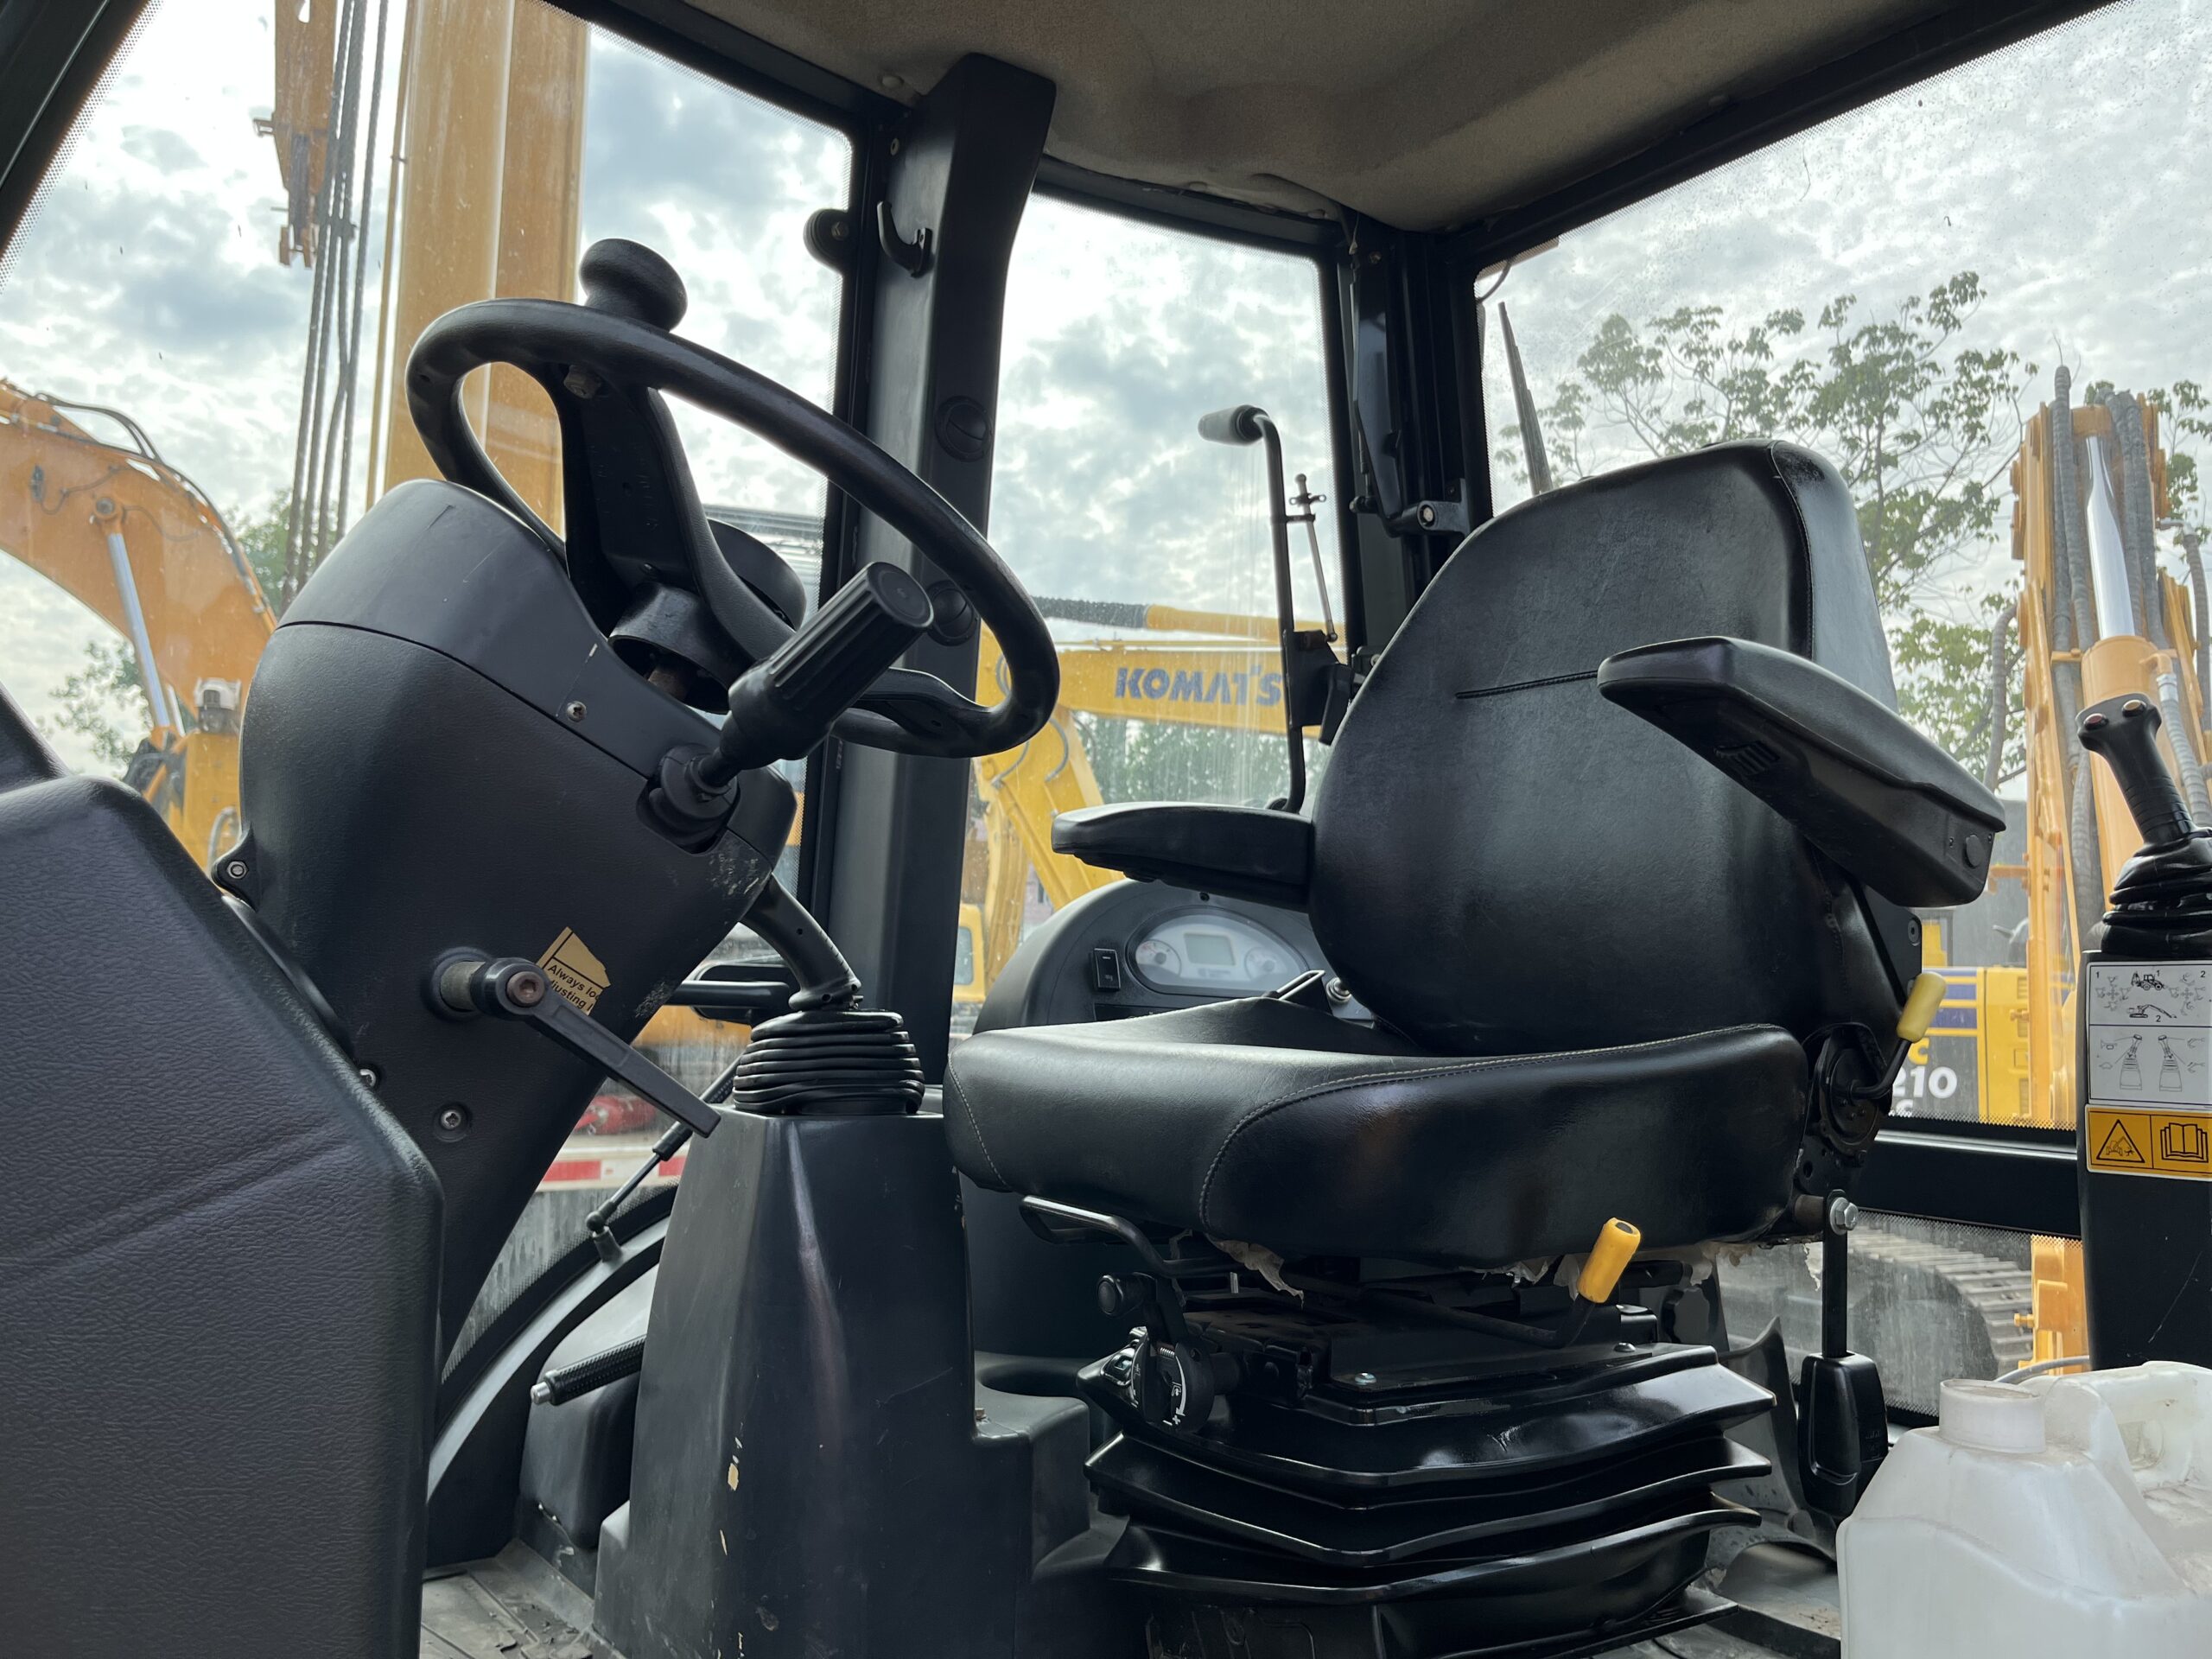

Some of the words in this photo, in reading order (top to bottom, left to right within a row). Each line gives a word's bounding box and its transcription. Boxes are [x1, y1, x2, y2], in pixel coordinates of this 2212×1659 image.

[1115, 666, 1282, 707] KOMATS
[548, 964, 585, 991] Always
[551, 980, 587, 1009] justing
[1892, 1065, 1957, 1098] 210
